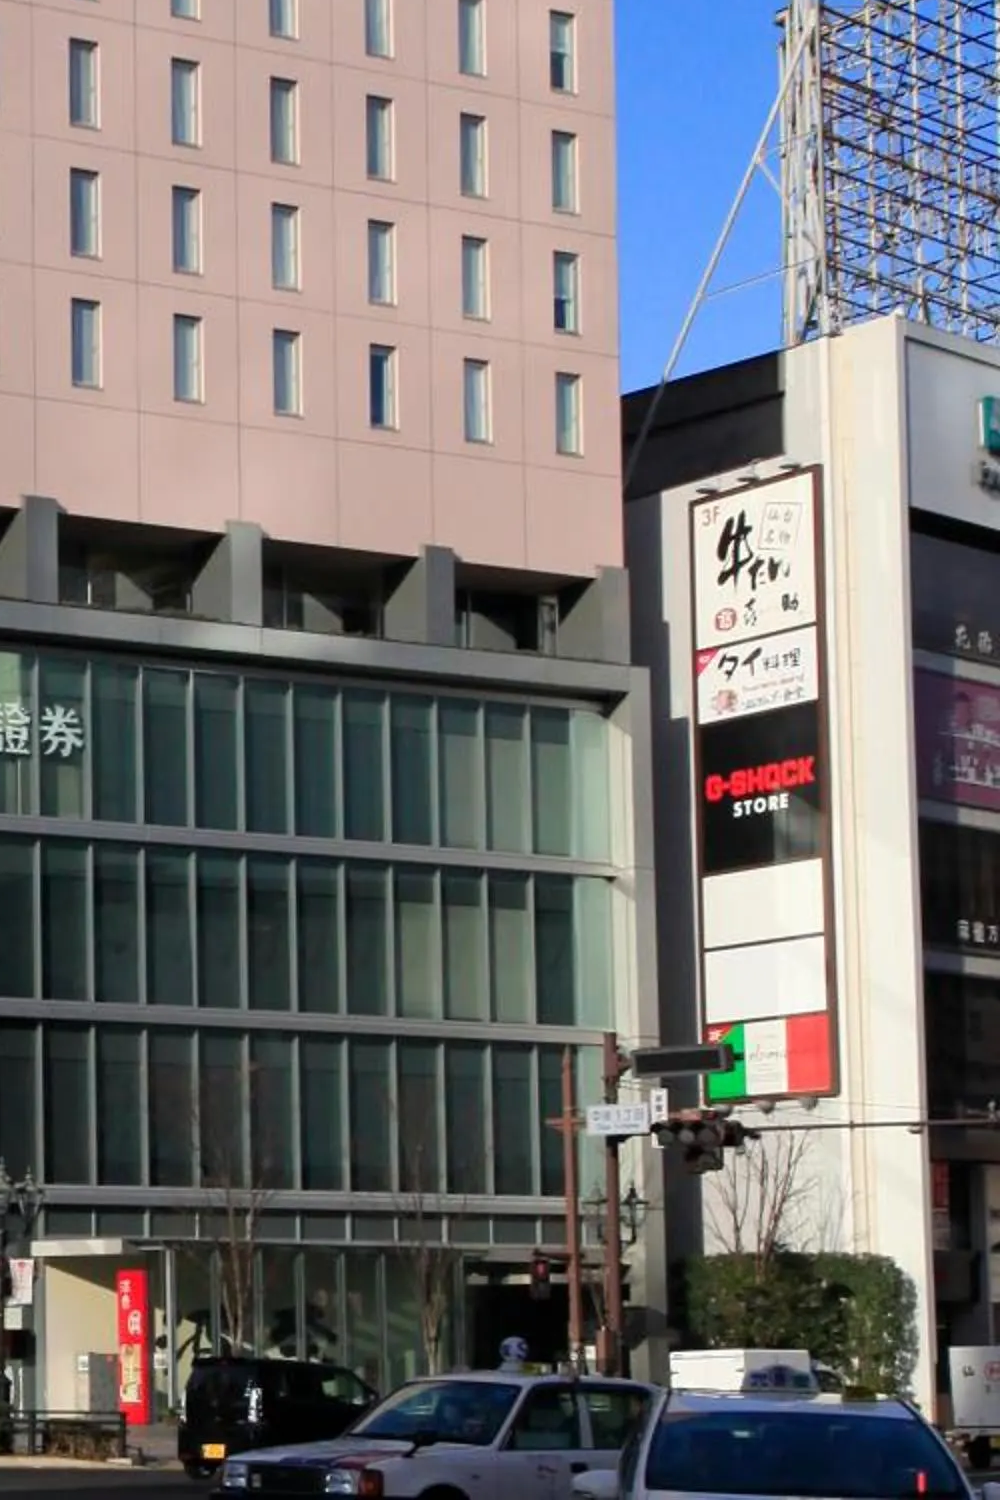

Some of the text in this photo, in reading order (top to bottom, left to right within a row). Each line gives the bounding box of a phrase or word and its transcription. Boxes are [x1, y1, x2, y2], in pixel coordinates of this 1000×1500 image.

[718, 647, 801, 681] タイ料理
[705, 757, 816, 802] G-SHOCK
[732, 793, 790, 818] STORE
